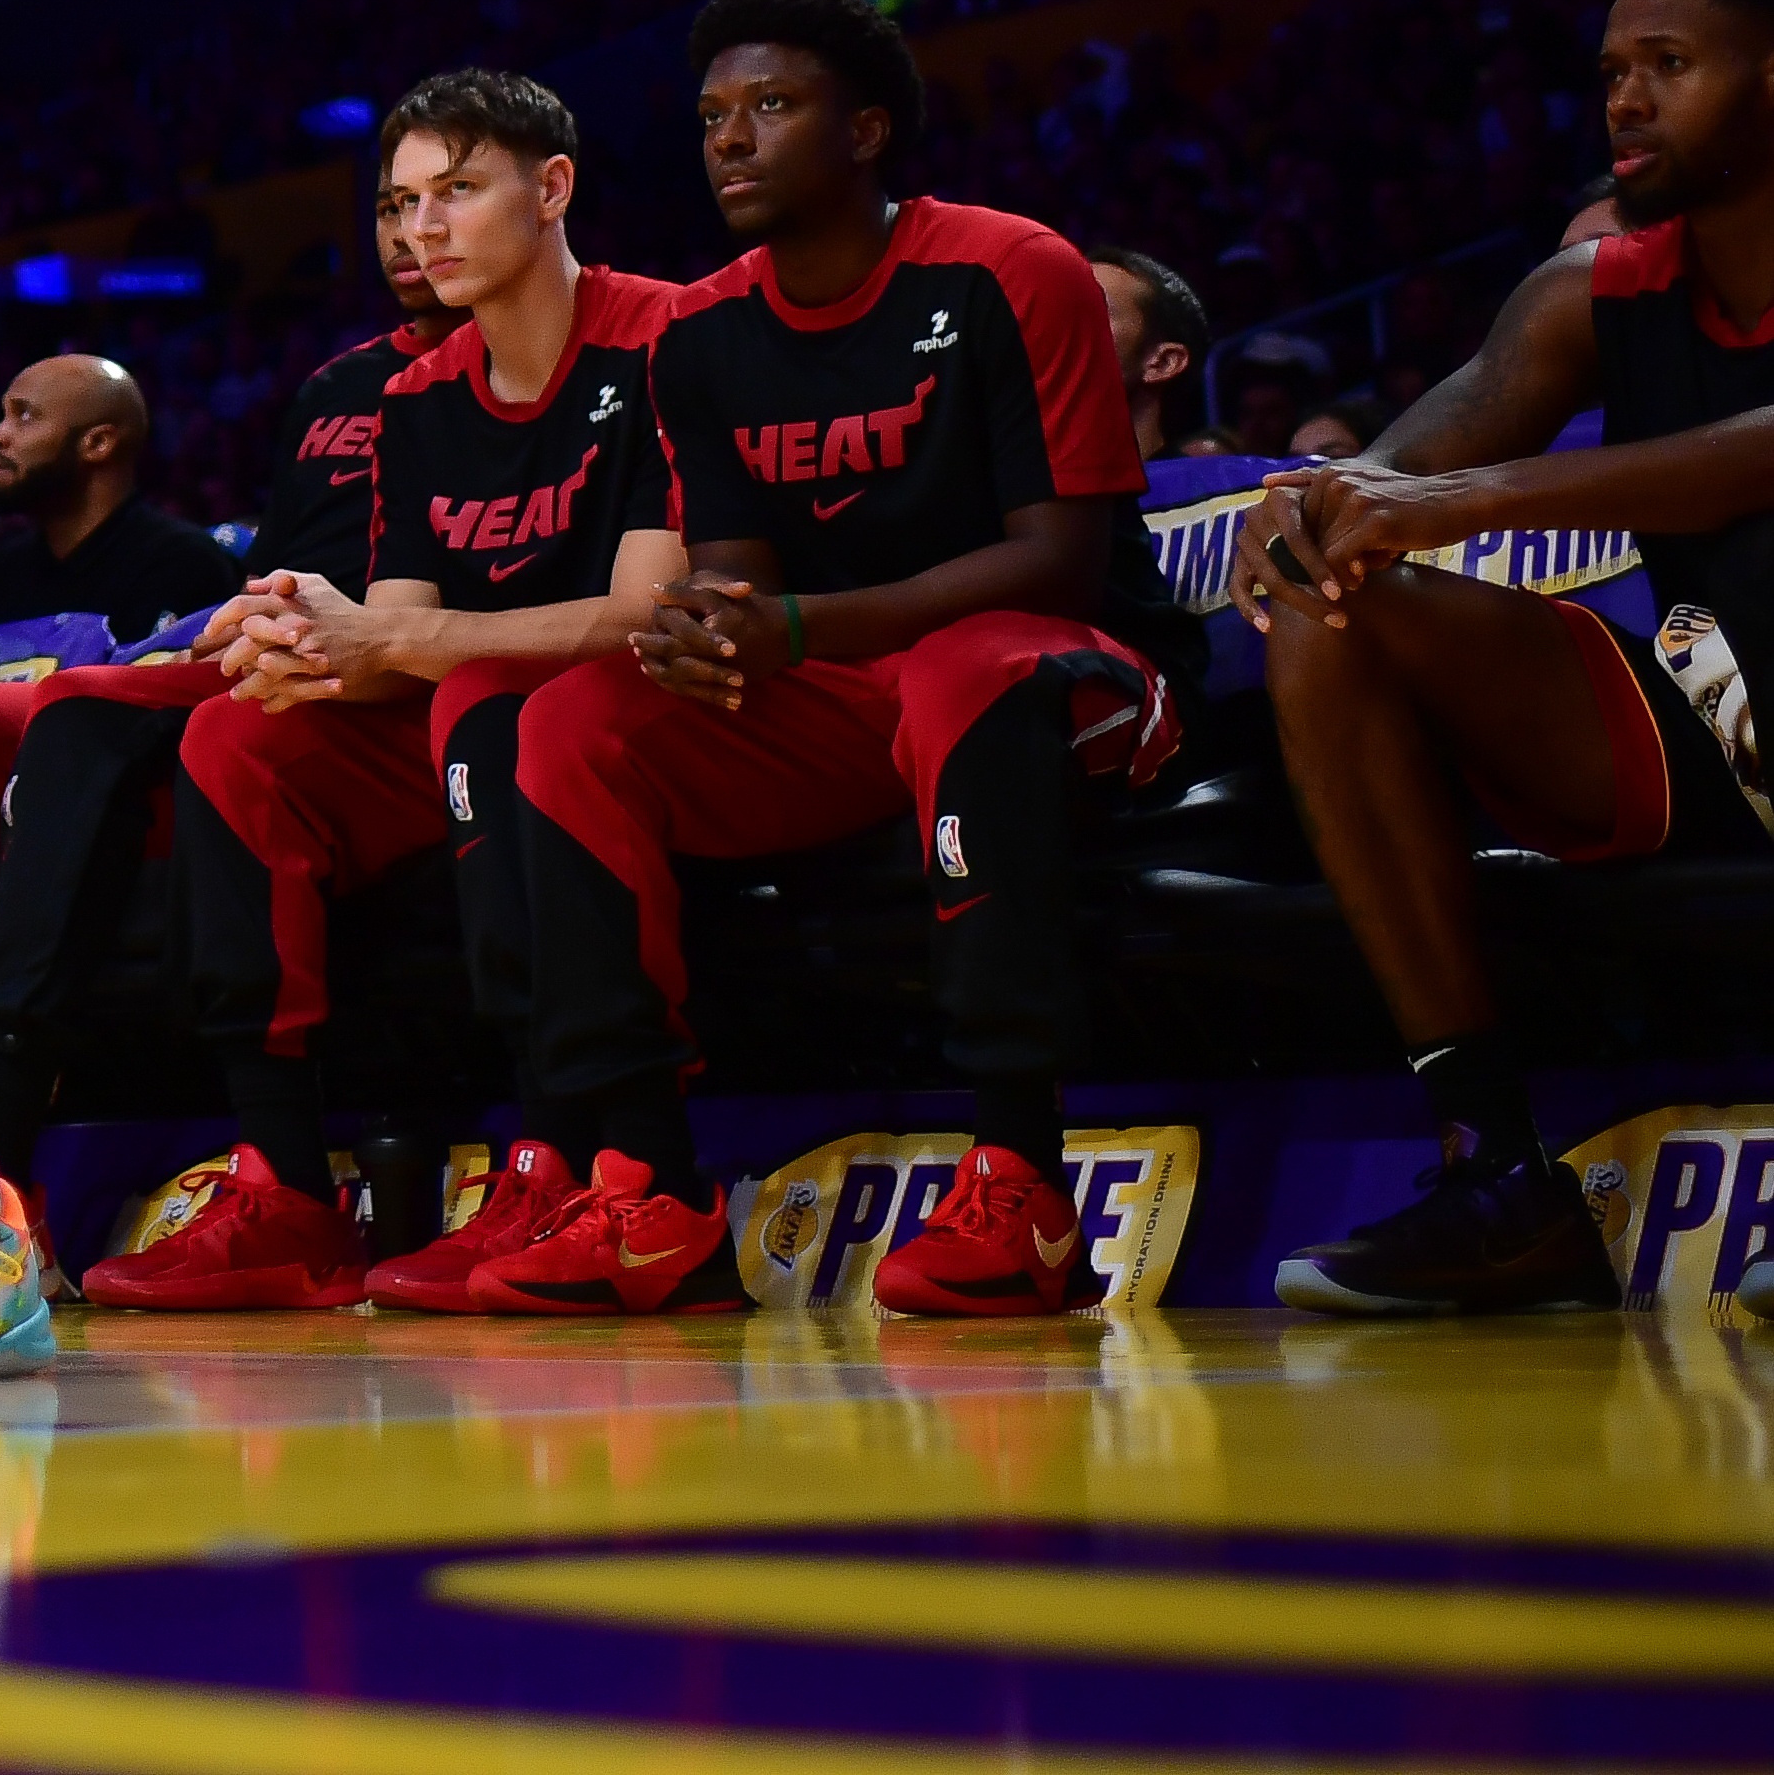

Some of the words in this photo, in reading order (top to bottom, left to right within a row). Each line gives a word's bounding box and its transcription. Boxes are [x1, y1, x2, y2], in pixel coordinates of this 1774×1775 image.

[734, 374, 937, 483] HEAT
[429, 443, 600, 551] HEAT
[1124, 1206, 1162, 1304] HYDRATION
[1156, 1151, 1178, 1205] DRINK
